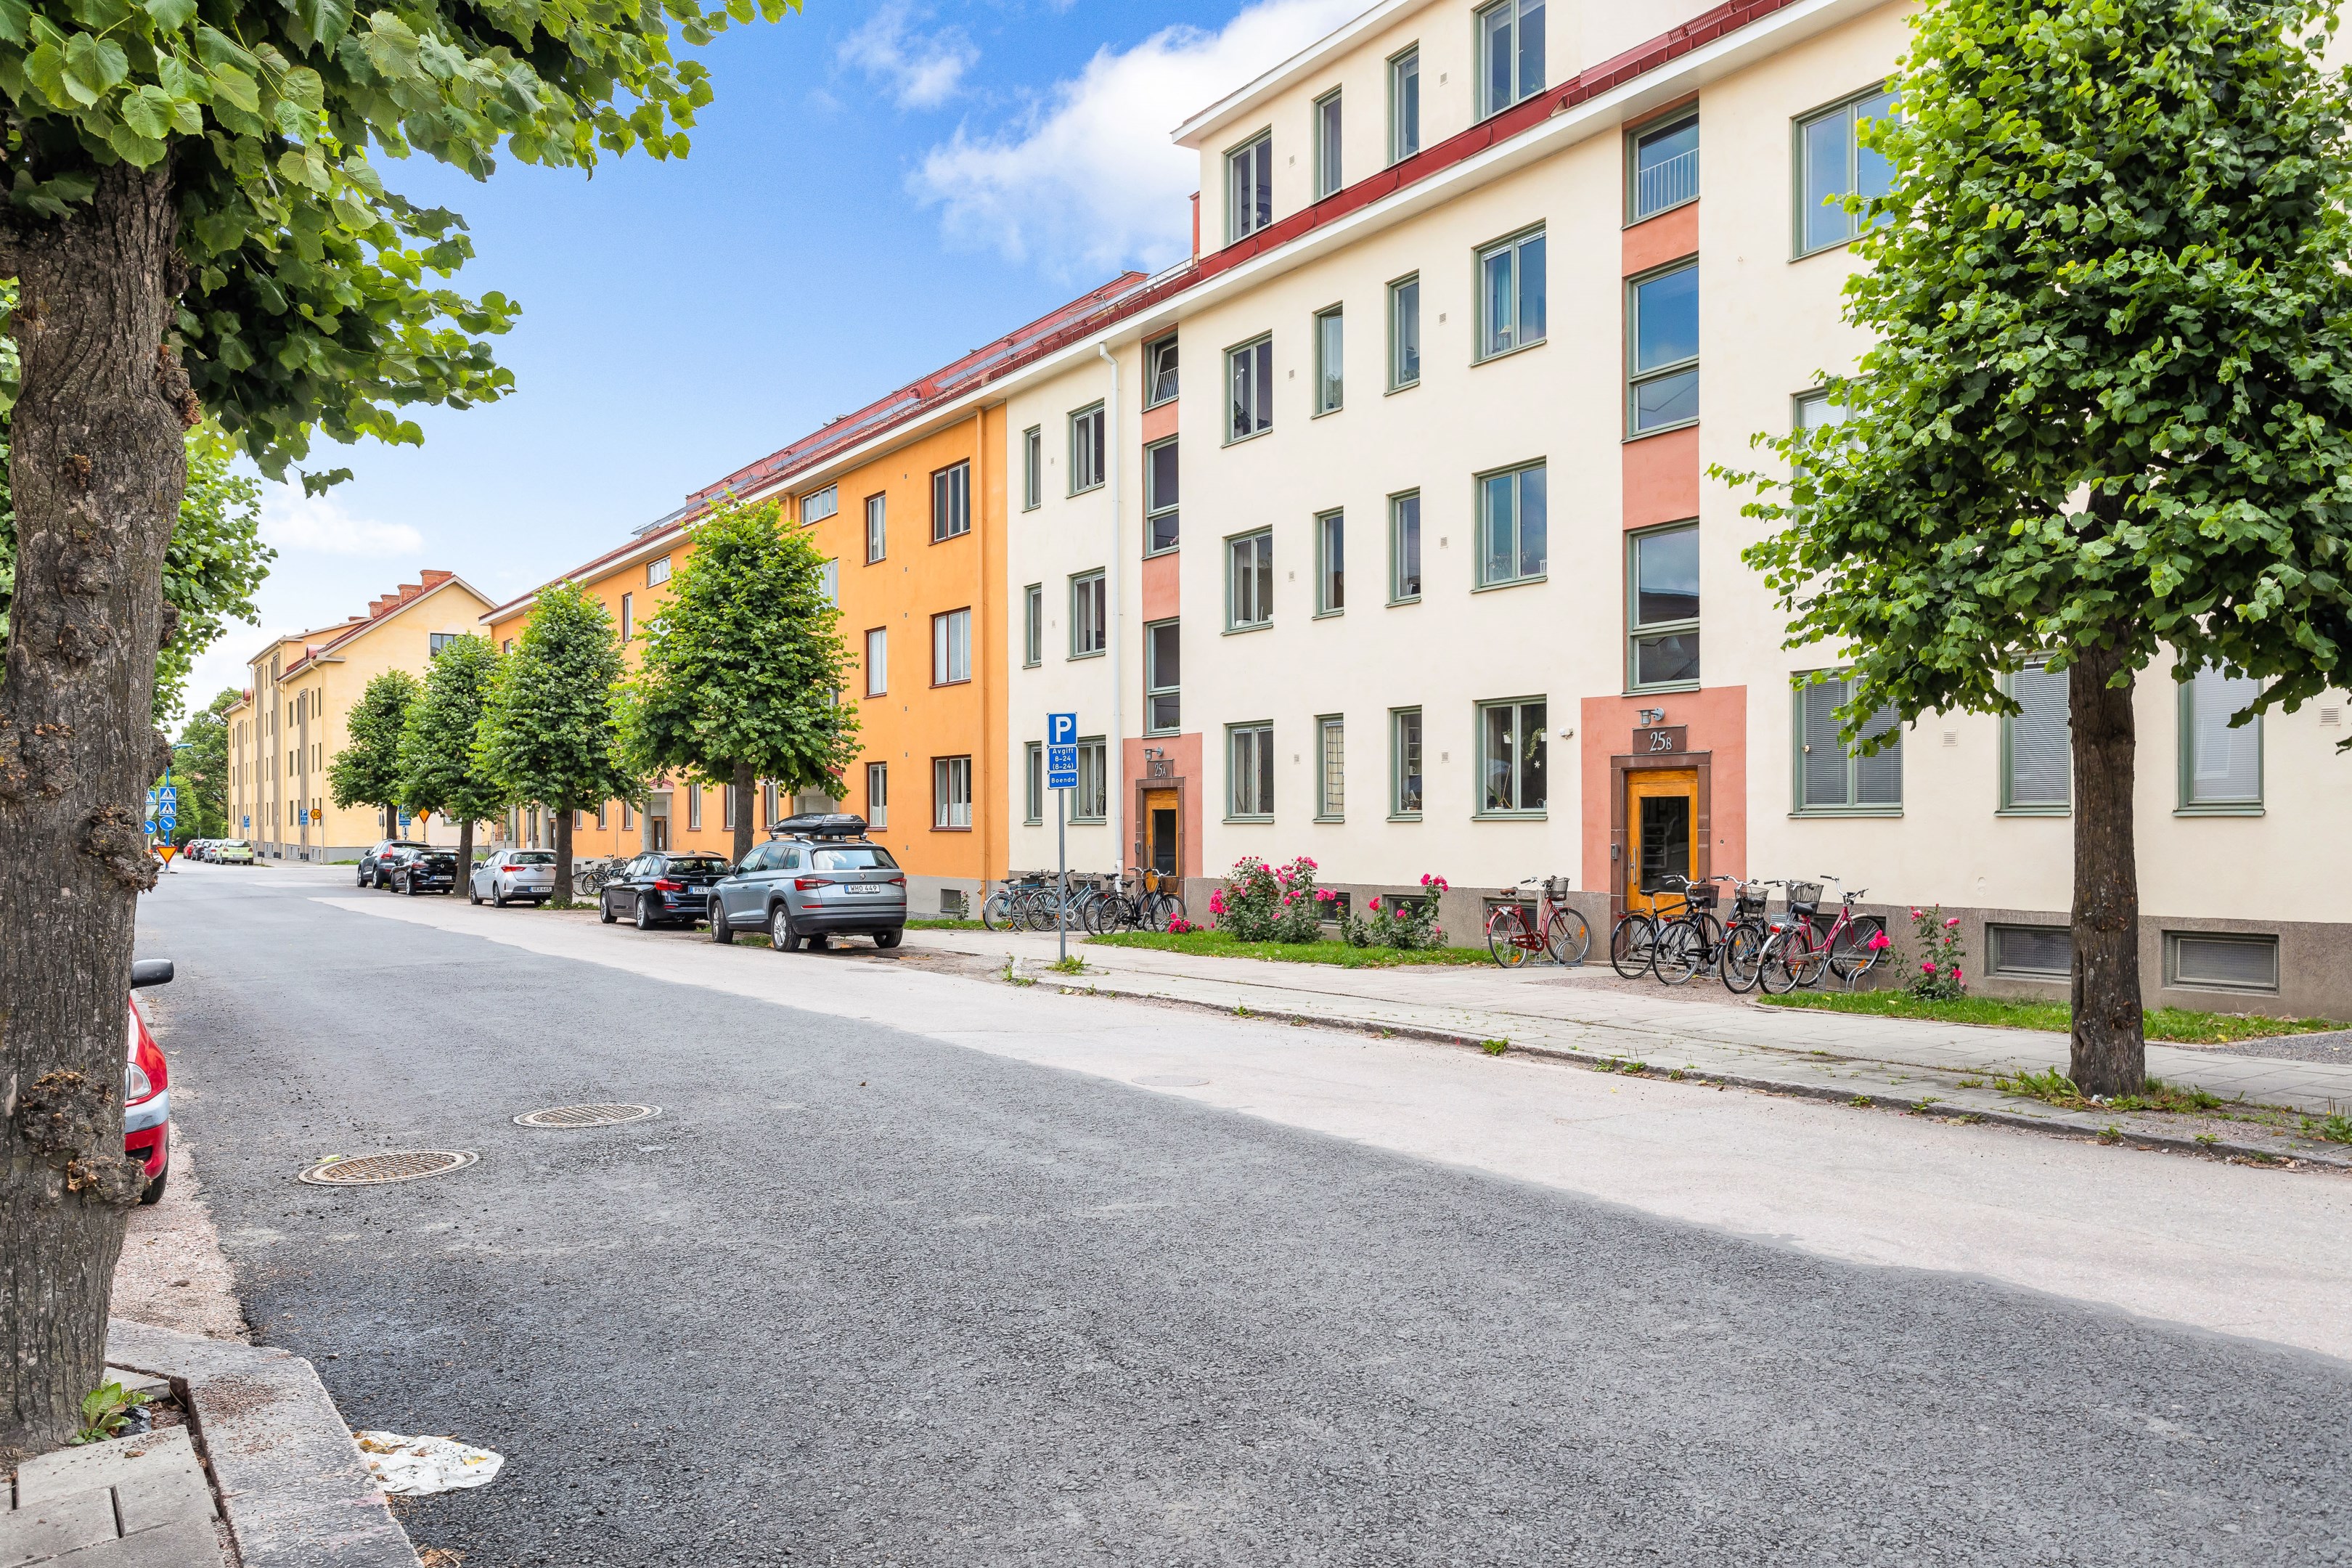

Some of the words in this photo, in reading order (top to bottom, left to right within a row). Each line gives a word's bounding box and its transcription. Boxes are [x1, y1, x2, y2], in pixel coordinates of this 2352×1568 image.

[1055, 716, 1072, 743] P
[1649, 731, 1673, 752] 25B
[1154, 762, 1167, 777] 25A
